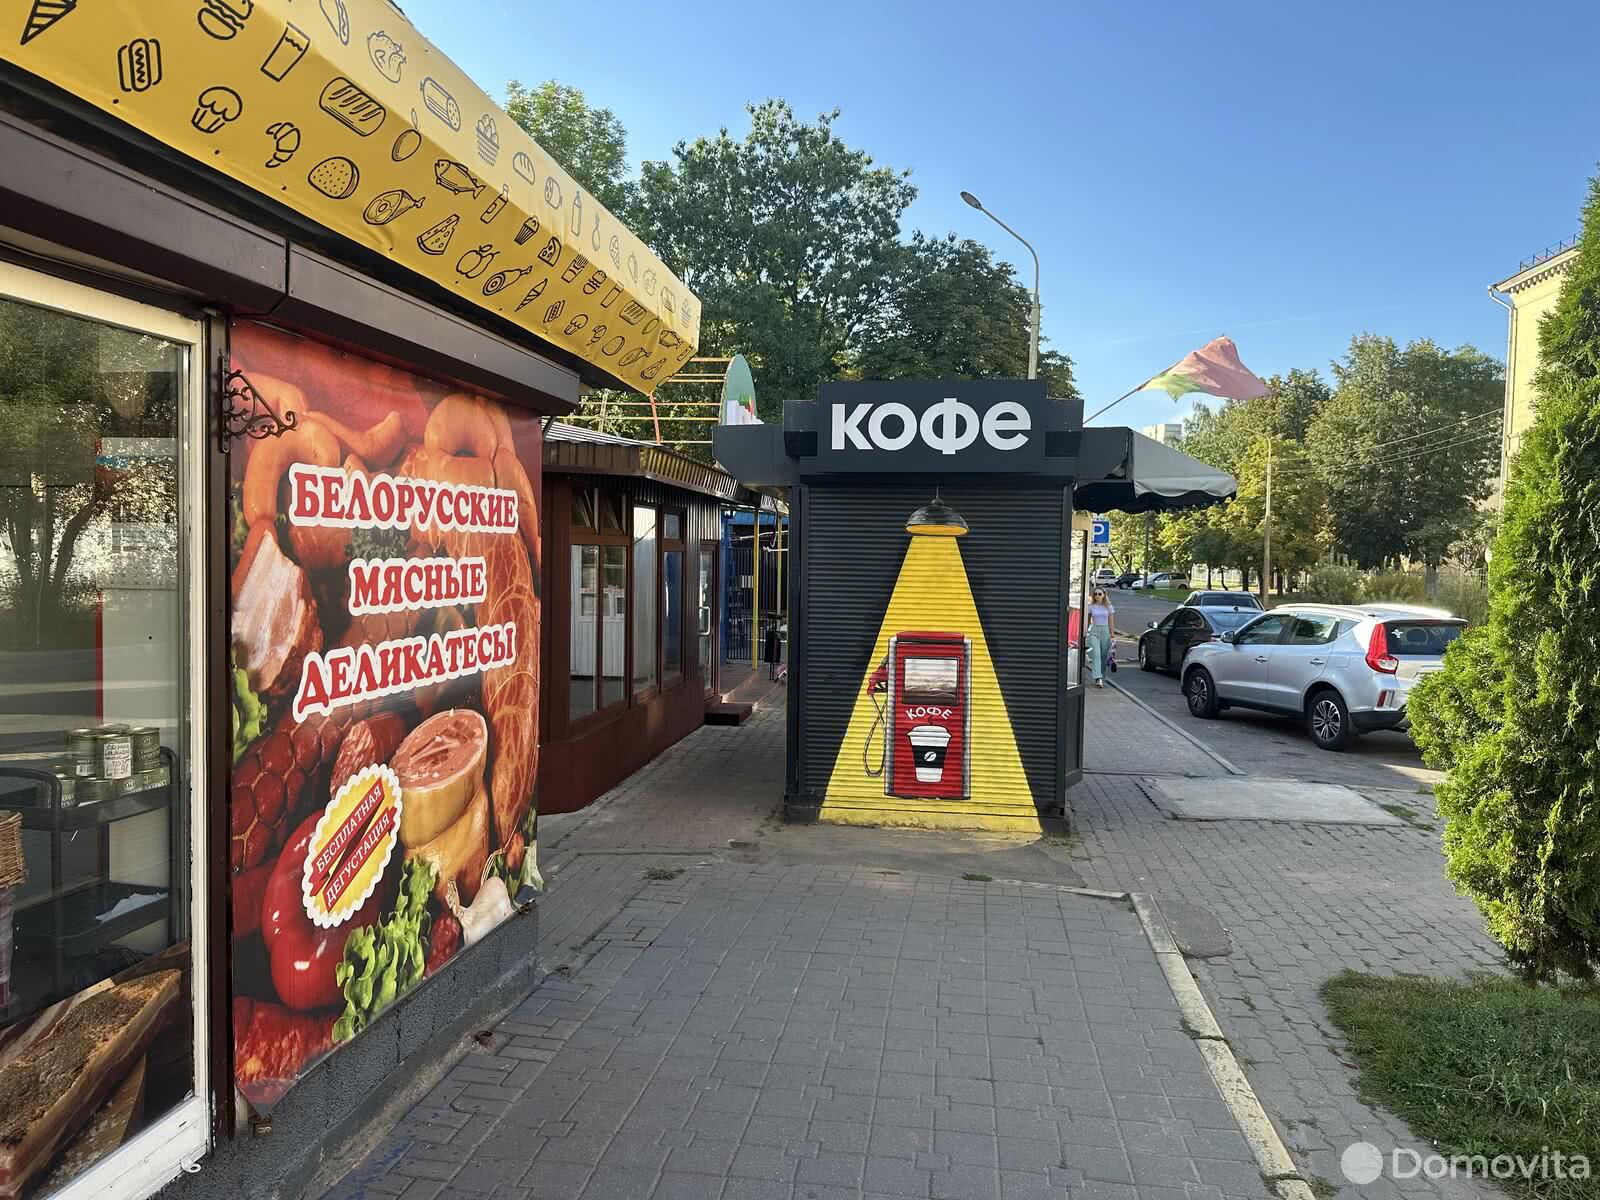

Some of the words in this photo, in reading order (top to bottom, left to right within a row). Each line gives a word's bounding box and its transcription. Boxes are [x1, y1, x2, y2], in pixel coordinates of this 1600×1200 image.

[293, 472, 516, 528] БЕЛОРУССКИЕ
[1092, 523, 1105, 543] P
[352, 563, 485, 608] МЯСНЫЕ
[297, 626, 514, 714] ДЕЛИКАТЕСЫ
[905, 706, 952, 721] КОФЕ
[315, 784, 382, 873] БЕСПЛАТНАЯ
[326, 813, 390, 907] ДЕГУСТАЦИЯ
